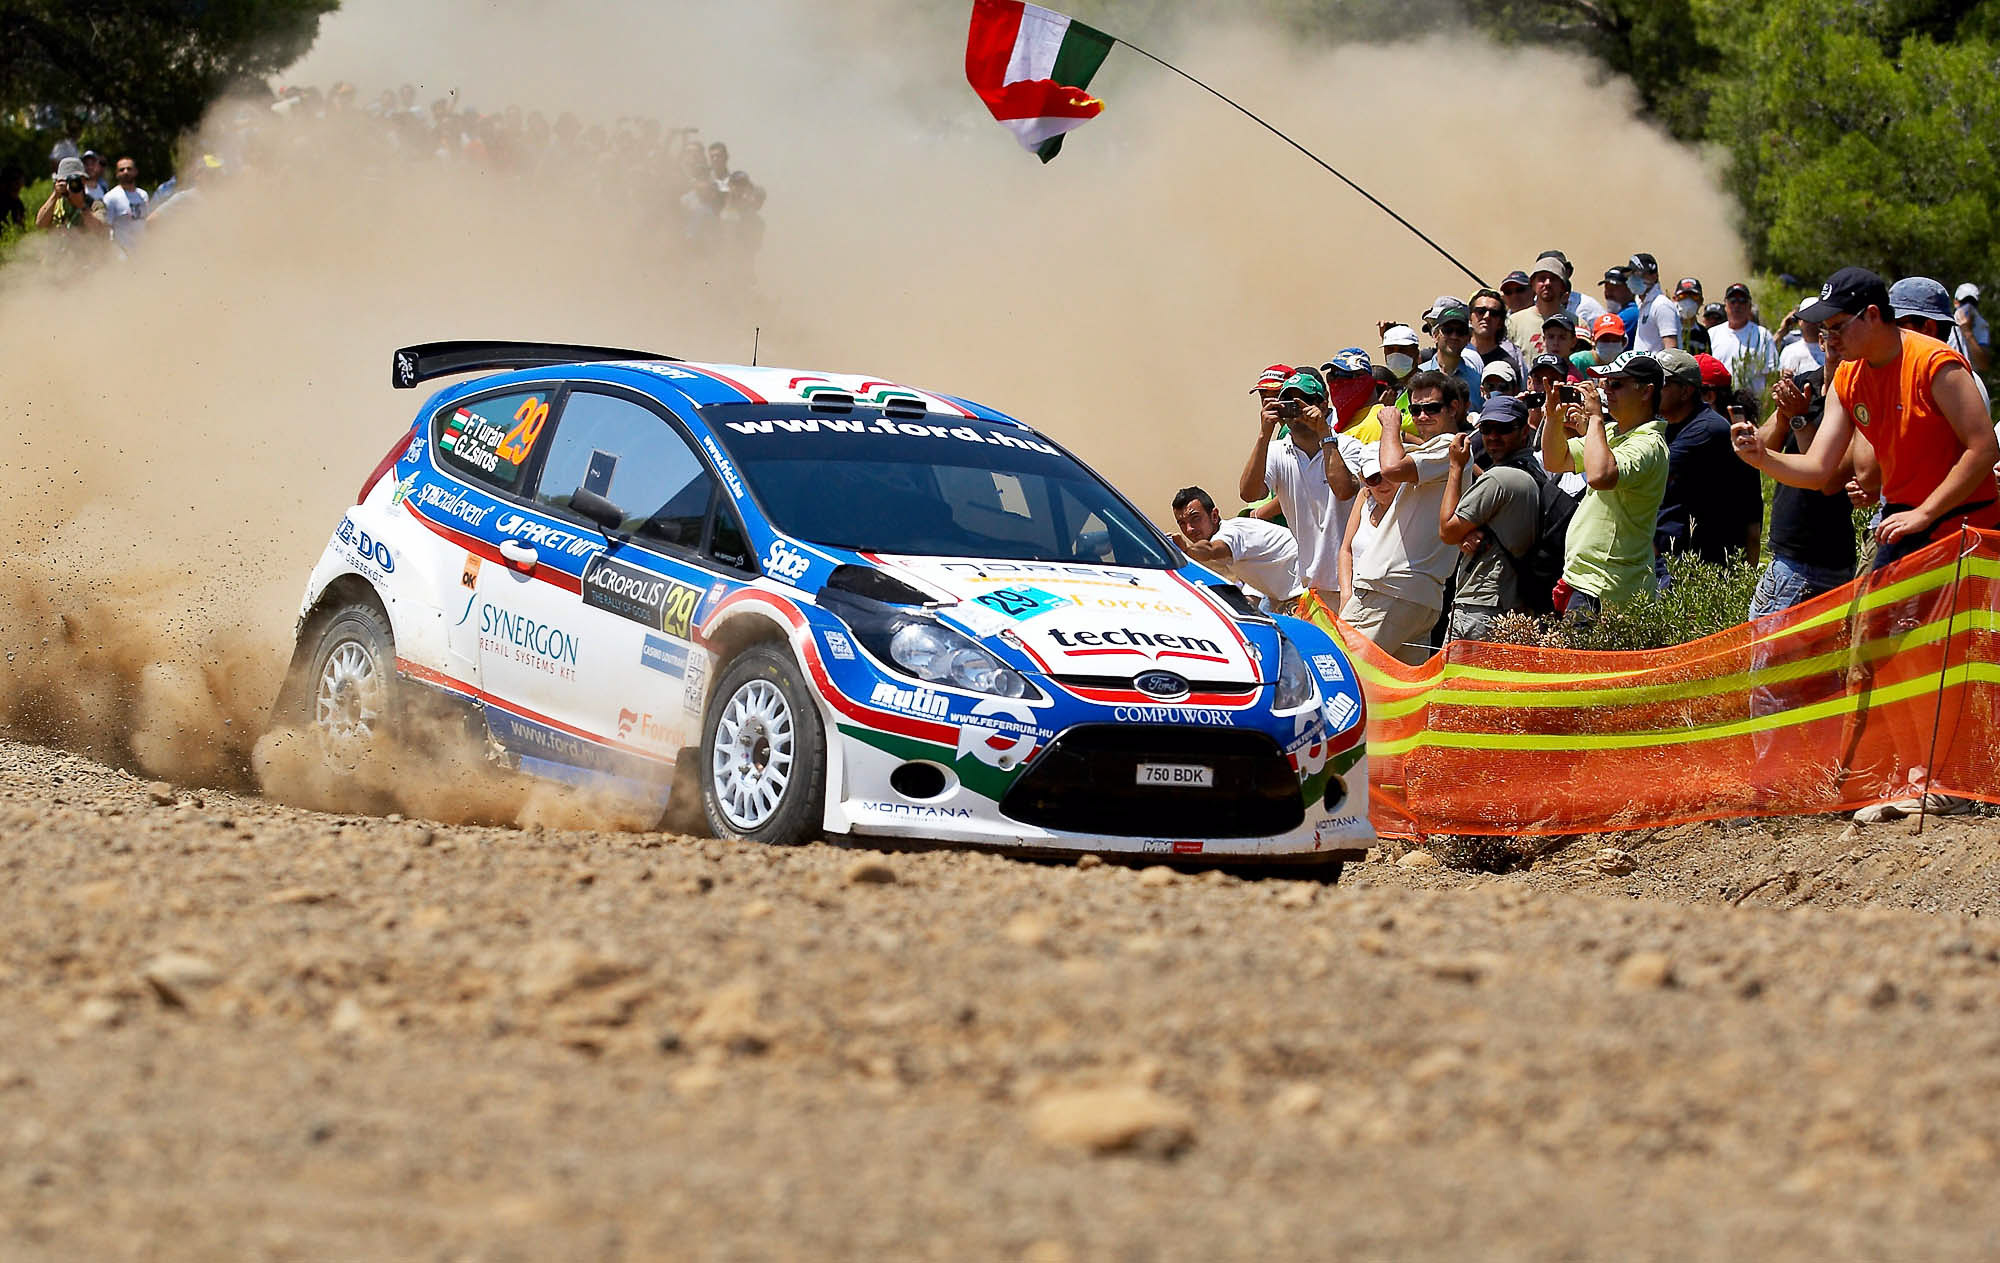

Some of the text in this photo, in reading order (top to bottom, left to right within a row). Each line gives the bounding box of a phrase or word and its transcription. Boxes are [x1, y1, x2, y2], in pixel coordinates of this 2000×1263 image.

[495, 397, 549, 466] 29
[725, 417, 1061, 456] www.ford.hu
[454, 434, 499, 473] G.Zsiros
[762, 539, 811, 579] Spice
[463, 572, 477, 590] OK
[587, 563, 664, 606] ACROPOLIS
[664, 586, 696, 638] 29
[977, 590, 1039, 616] 29
[481, 604, 579, 665] SYNERGON
[1048, 627, 1224, 655] techem
[479, 637, 509, 658] RETAIL
[515, 649, 555, 674] SYSTEMS
[870, 682, 950, 717] Rutin
[1148, 676, 1178, 692] Ford
[950, 712, 1054, 738] WWW.FEFERRUM.HU
[1114, 706, 1234, 726] COMPUWORX
[1145, 767, 1204, 783] 750 BDK
[863, 802, 970, 818] MONTANA
